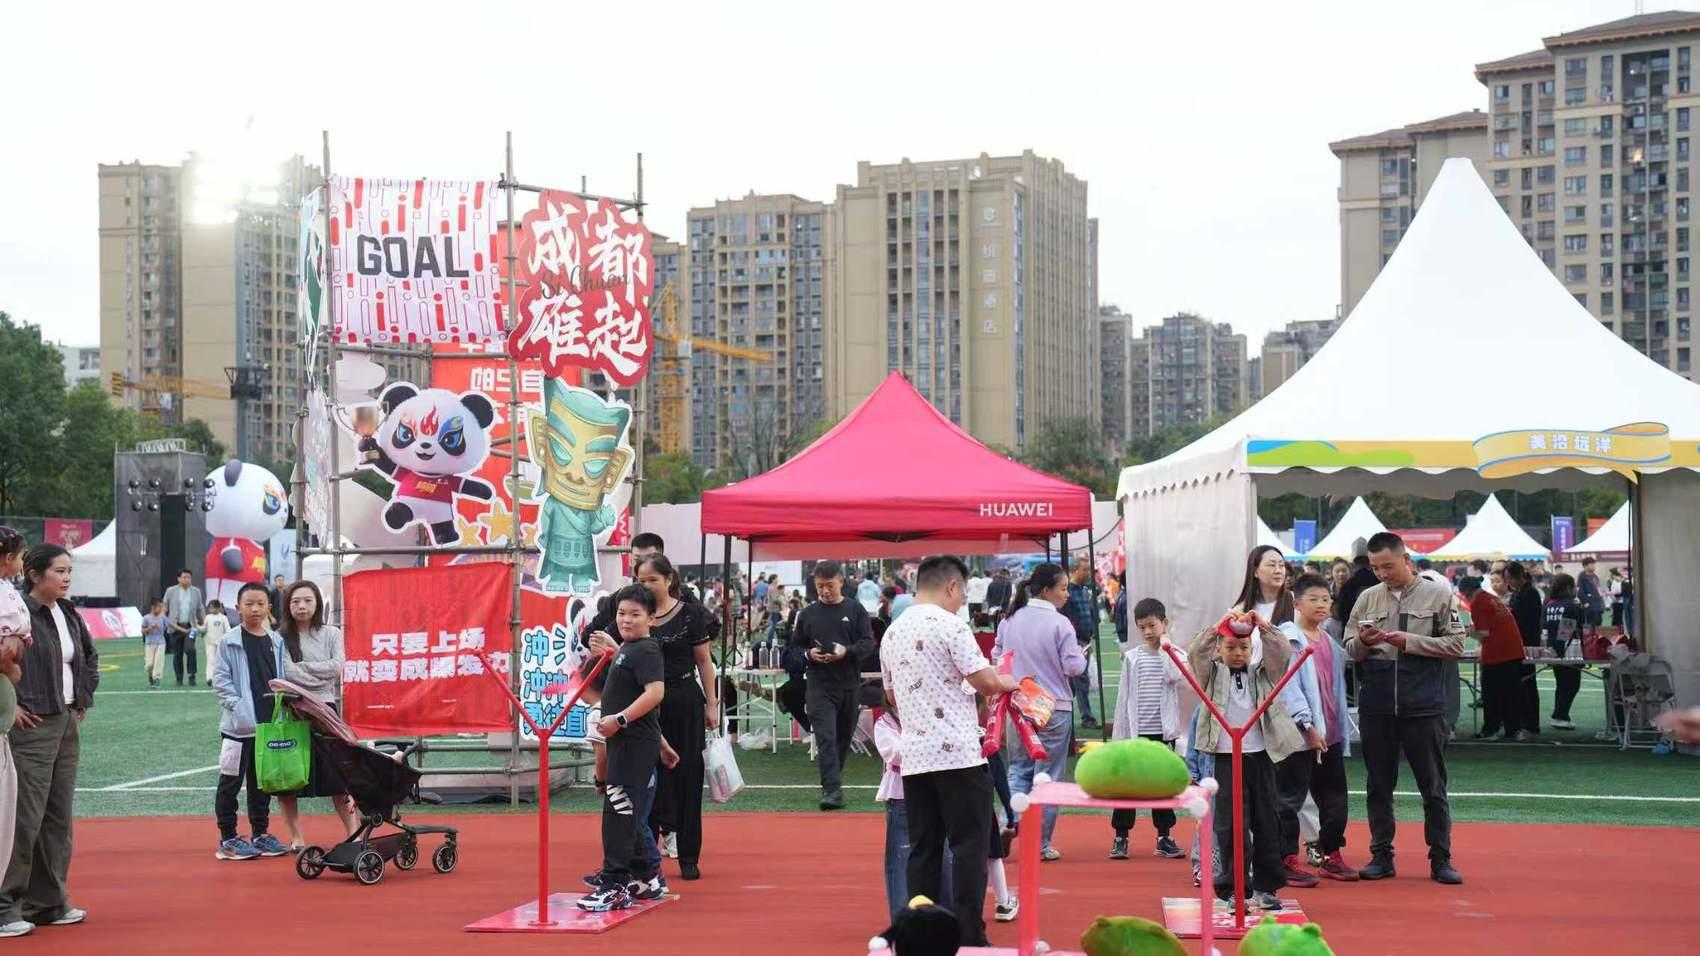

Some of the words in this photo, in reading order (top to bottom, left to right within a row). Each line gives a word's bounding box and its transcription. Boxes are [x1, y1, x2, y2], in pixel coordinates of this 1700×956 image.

[357, 234, 470, 279] GOAL
[528, 200, 648, 306] 成都
[517, 281, 648, 376] 雄起
[979, 502, 1053, 518] HUAWEI
[370, 627, 486, 657] 只要上场
[523, 630, 550, 667] 冲
[522, 702, 594, 738] 勇往直
